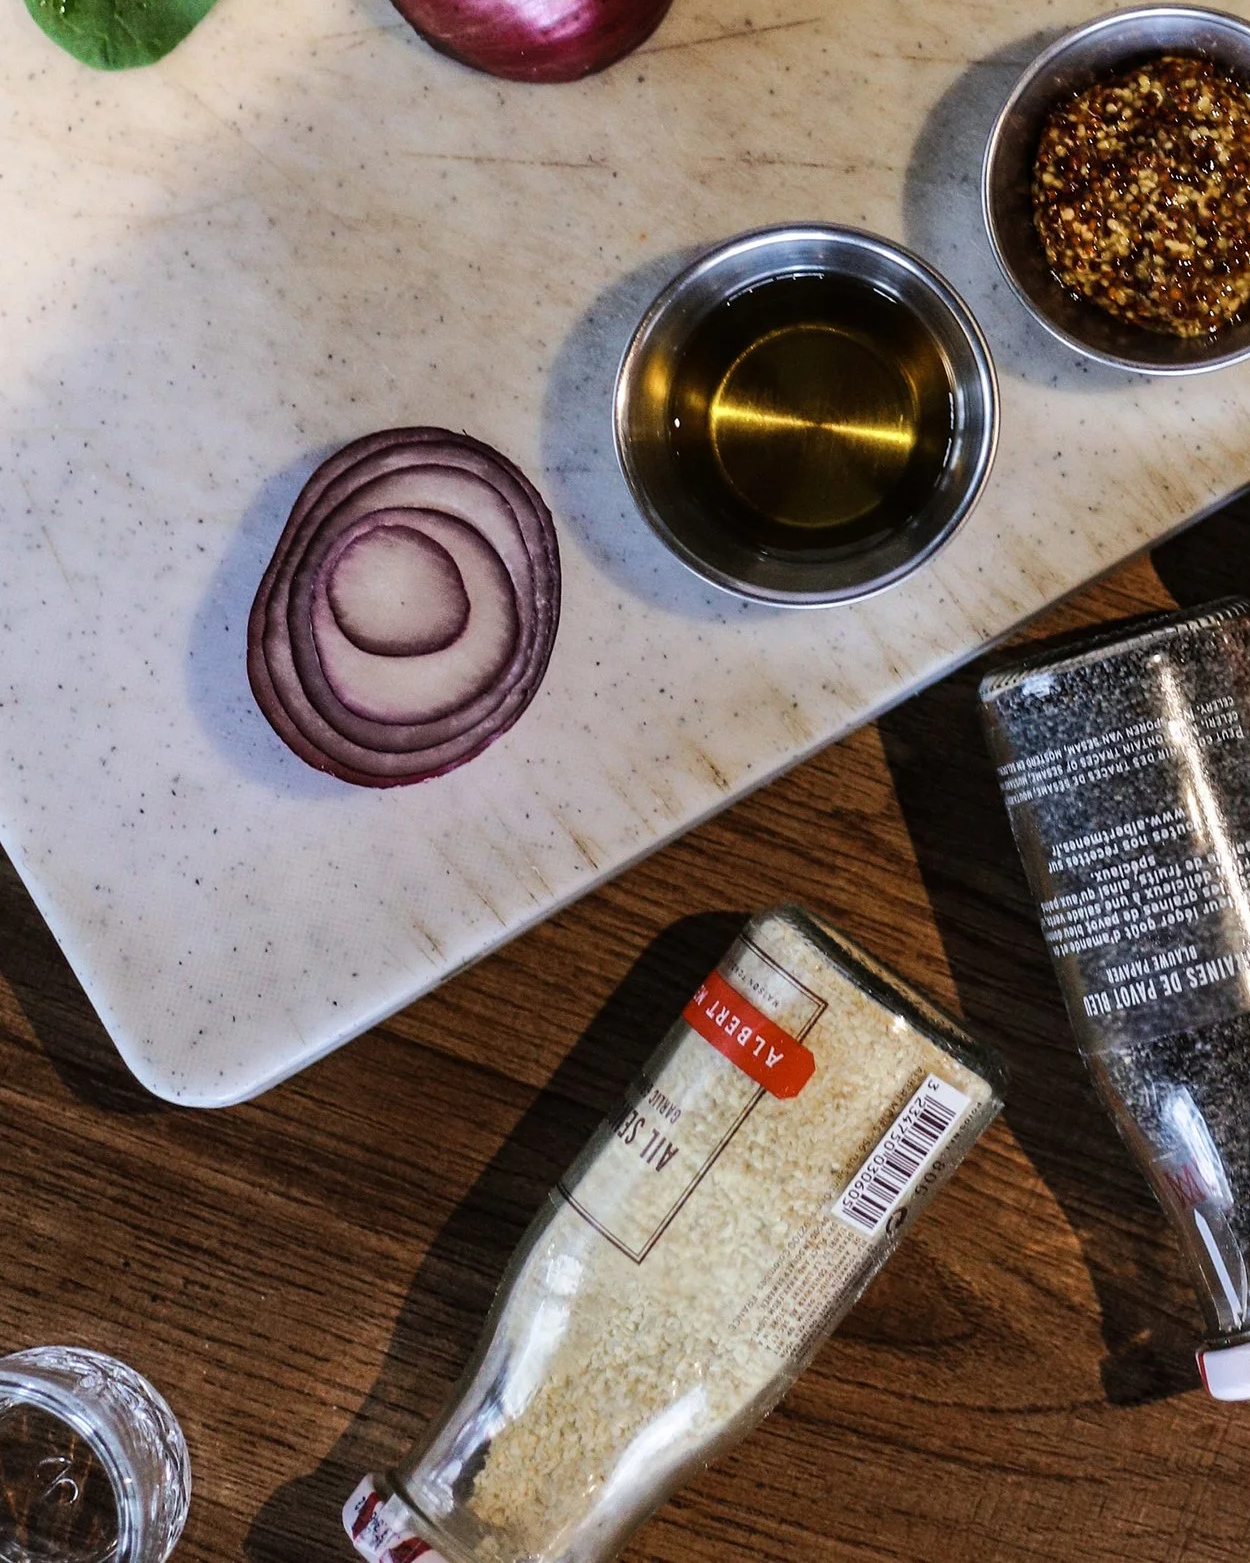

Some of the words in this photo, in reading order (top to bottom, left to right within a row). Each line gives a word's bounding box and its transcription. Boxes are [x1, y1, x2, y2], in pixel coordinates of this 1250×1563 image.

[1101, 730, 1122, 744] VAN
[1122, 732, 1169, 755] ONTAIN
[1216, 725, 1244, 741] PEUT
[1063, 736, 1099, 755] SESAM,
[1079, 746, 1119, 767] TRACES
[1157, 735, 1212, 759] CONIR
[1064, 759, 1078, 772] OF
[1087, 760, 1129, 782] TRACES
[1131, 751, 1154, 768] DES
[1072, 773, 1085, 785] DE
[1121, 833, 1148, 852] nos
[1152, 818, 1199, 844] outes
[1047, 859, 1063, 873] sur
[1065, 843, 1119, 870] recettes
[1089, 853, 1156, 884] spéciaux.
[1184, 856, 1203, 872] de
[1134, 863, 1181, 889] fruits,
[1144, 870, 1212, 901] délicieux
[1059, 886, 1095, 908] qu'aux
[1098, 878, 1130, 900] ainsi
[1066, 903, 1101, 924] salade
[1104, 895, 1128, 911] une
[1142, 888, 1198, 916] graines
[1085, 911, 1119, 933] pavot
[1122, 907, 1139, 923] de
[1159, 903, 1198, 929] léger
[1063, 923, 1084, 939] bleu
[1123, 915, 1156, 941] goût
[1069, 928, 1121, 954] d'amande
[1151, 944, 1197, 971] BLAUWE
[1105, 958, 1150, 983] PAPAVER
[1112, 977, 1157, 1008] PAVOT
[1160, 971, 1181, 995] DE
[1082, 990, 1111, 1017] BLEU
[705, 997, 784, 1068] ALBERT
[926, 1079, 939, 1091] 3
[647, 1088, 681, 1123] GARLIC
[882, 1096, 926, 1152] 234750
[638, 1127, 679, 1173] AIL
[841, 1153, 885, 1208] 030605
[727, 1293, 758, 1331] FRANCE
